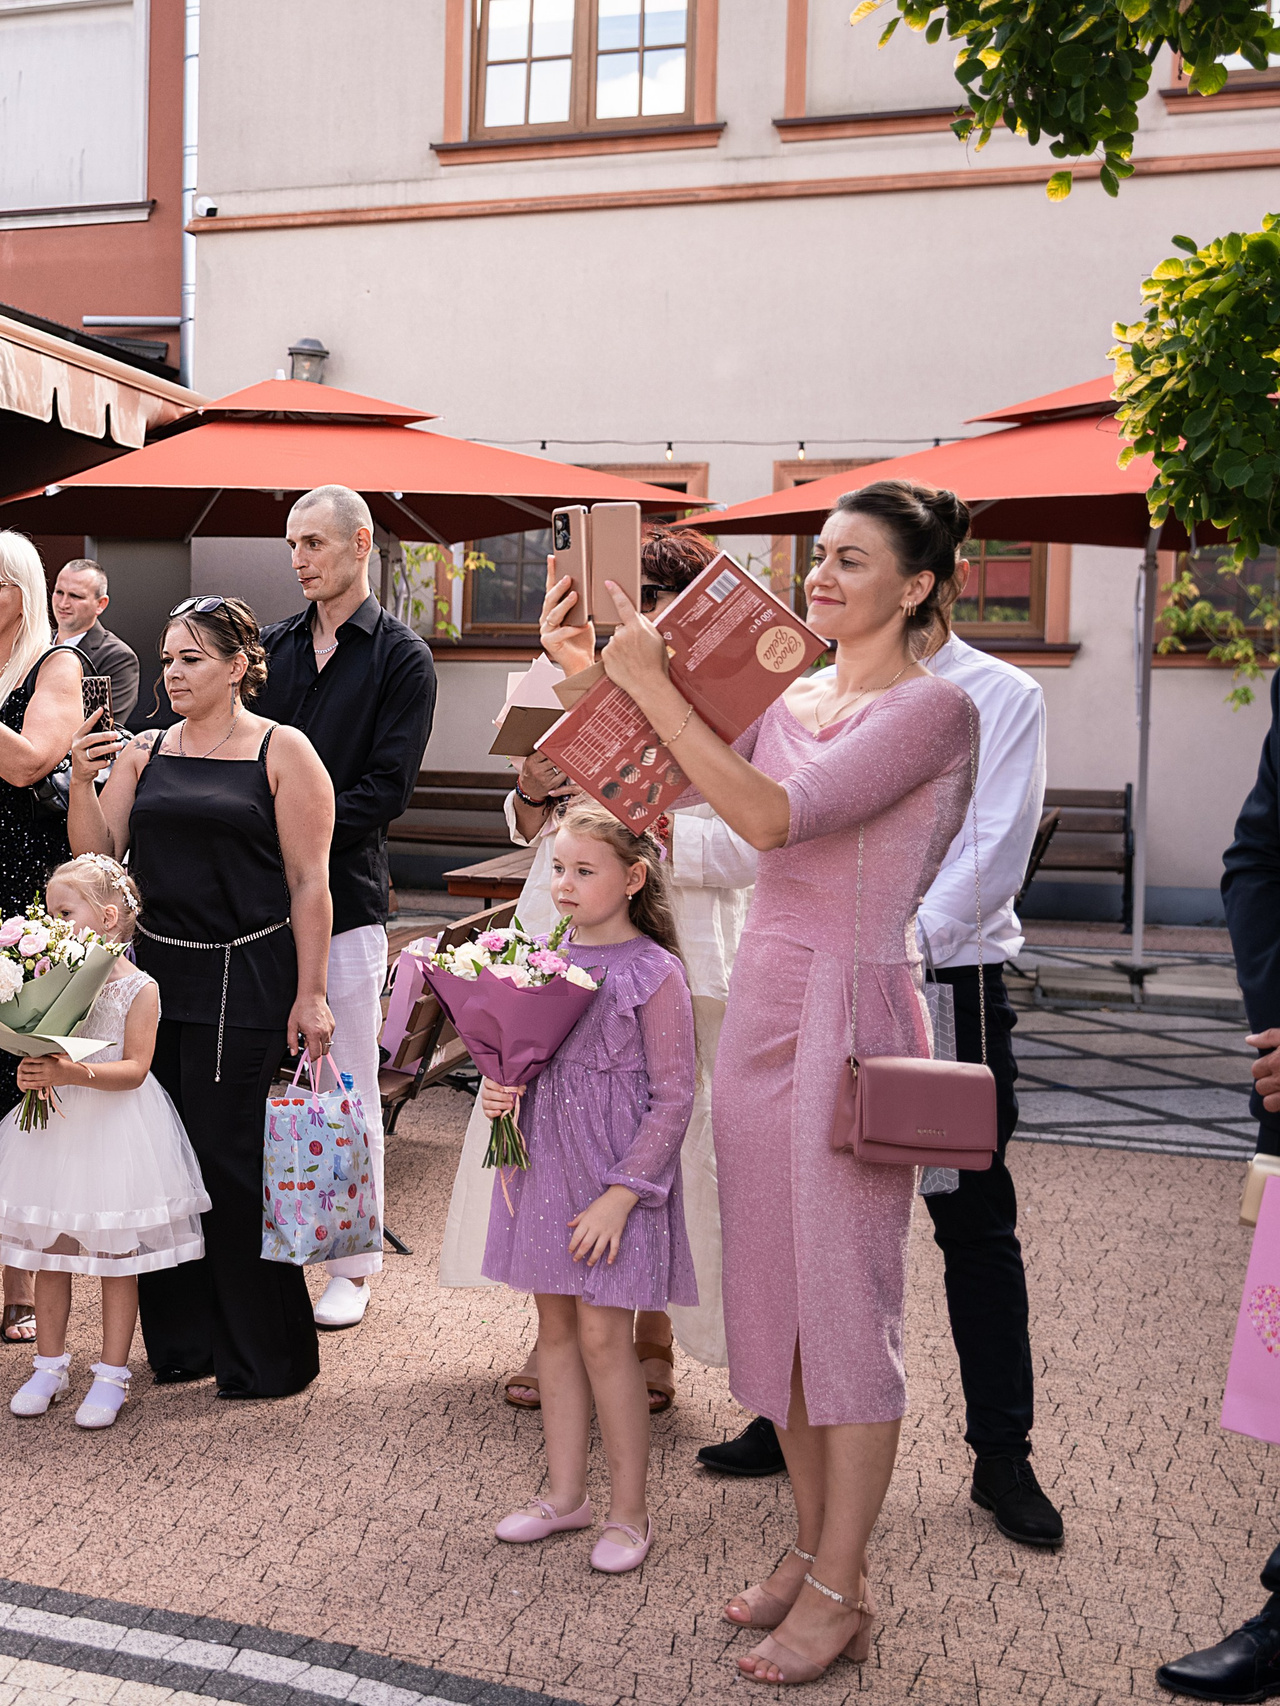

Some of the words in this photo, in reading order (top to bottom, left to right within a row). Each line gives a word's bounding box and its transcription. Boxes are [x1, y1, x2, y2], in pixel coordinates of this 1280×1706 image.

[760, 608, 773, 622] 400
[763, 629, 788, 661] Bella
[773, 636, 801, 670] Choco
